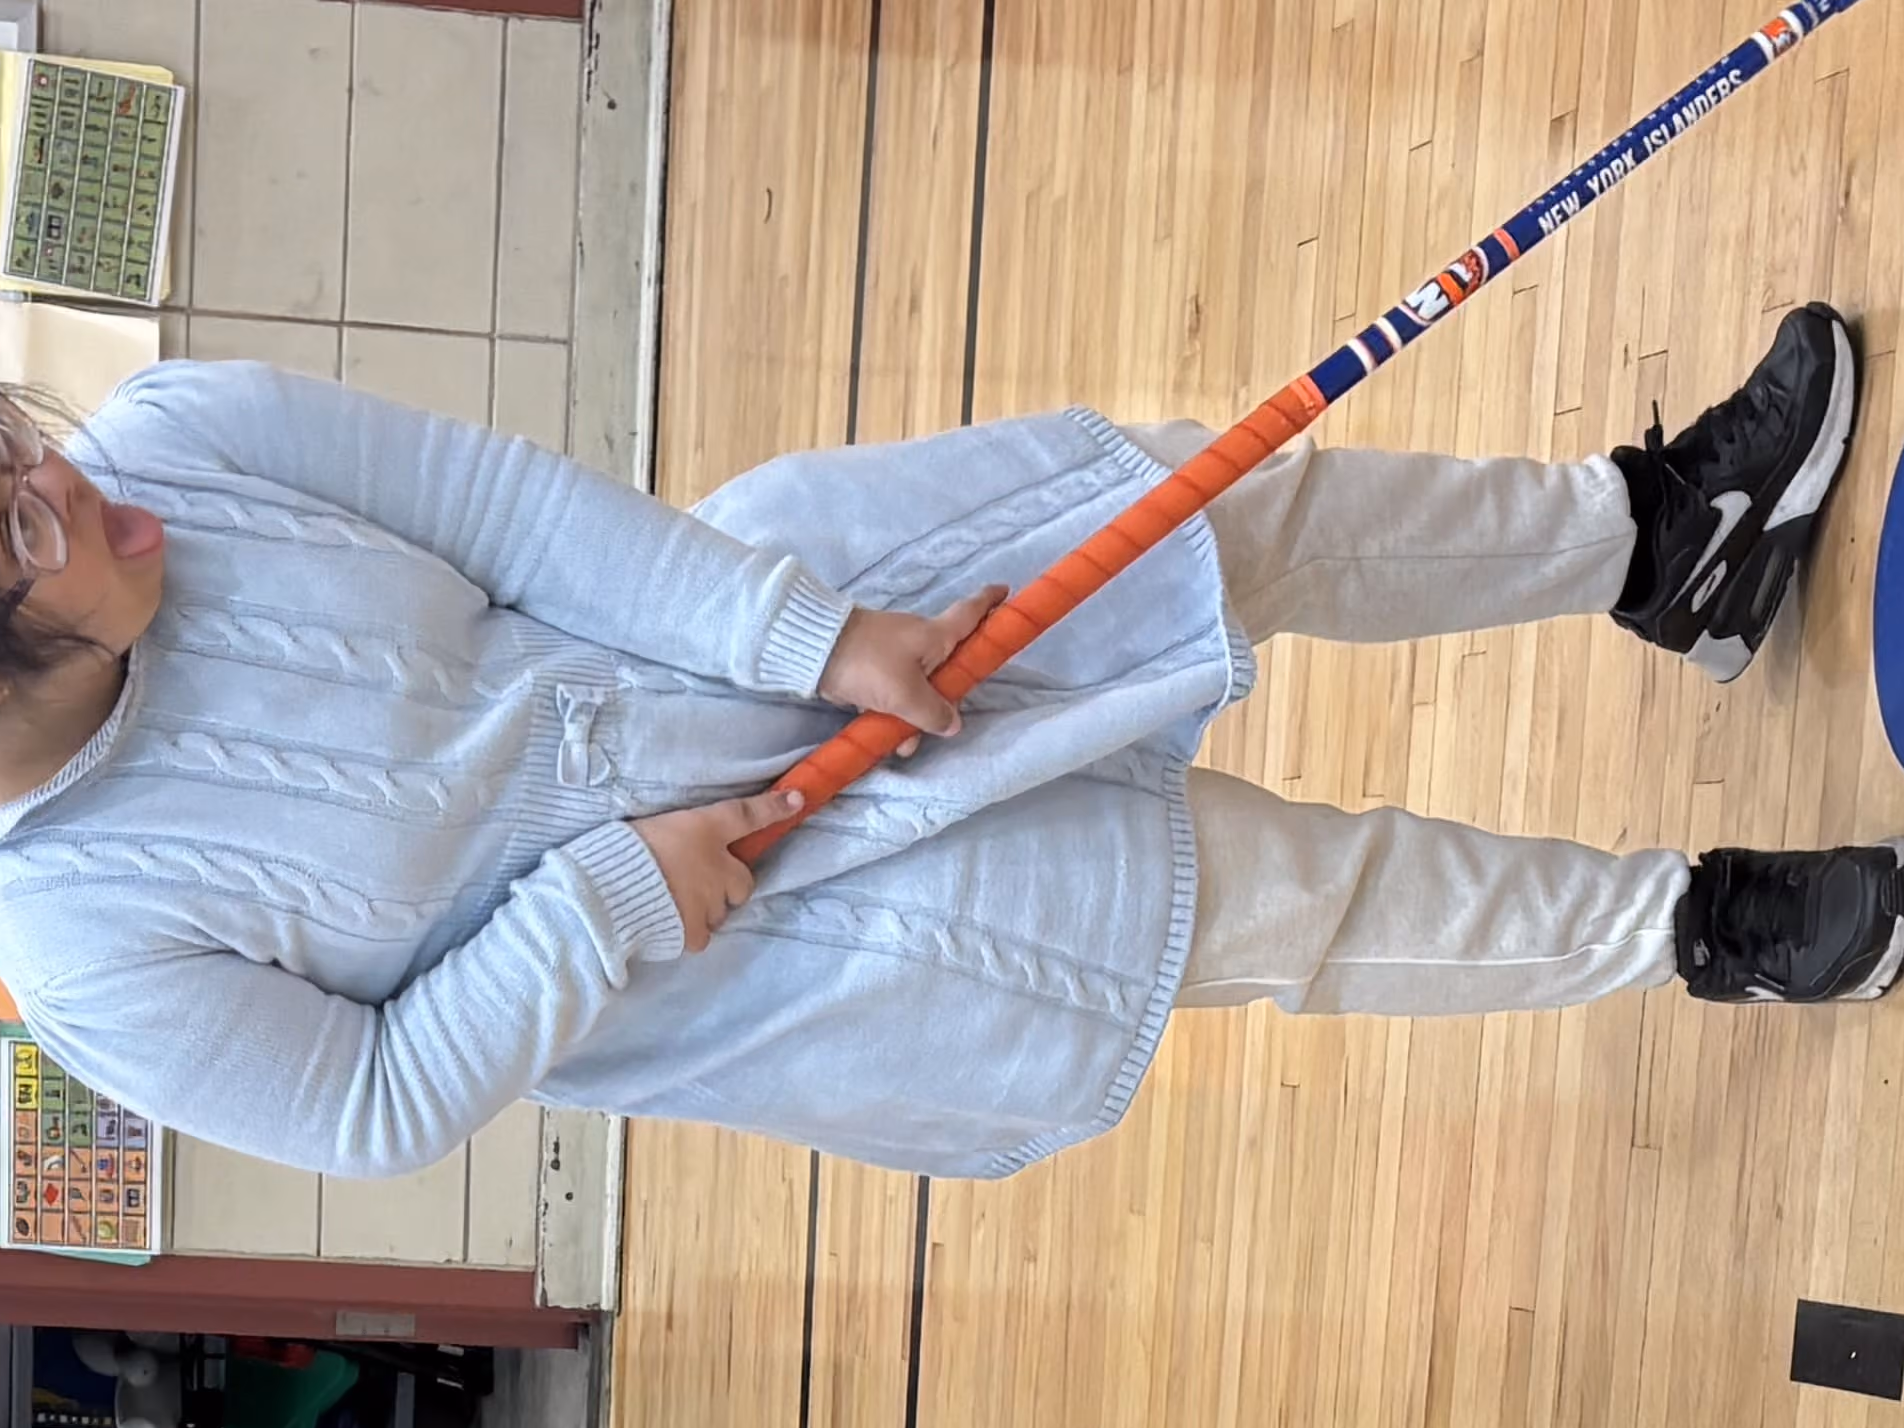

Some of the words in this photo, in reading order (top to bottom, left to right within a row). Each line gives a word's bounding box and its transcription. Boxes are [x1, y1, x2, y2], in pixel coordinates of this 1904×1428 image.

[1537, 190, 1585, 235] NEW
[1585, 150, 1640, 195] YORK
[1642, 68, 1746, 152] ISLANDERS
